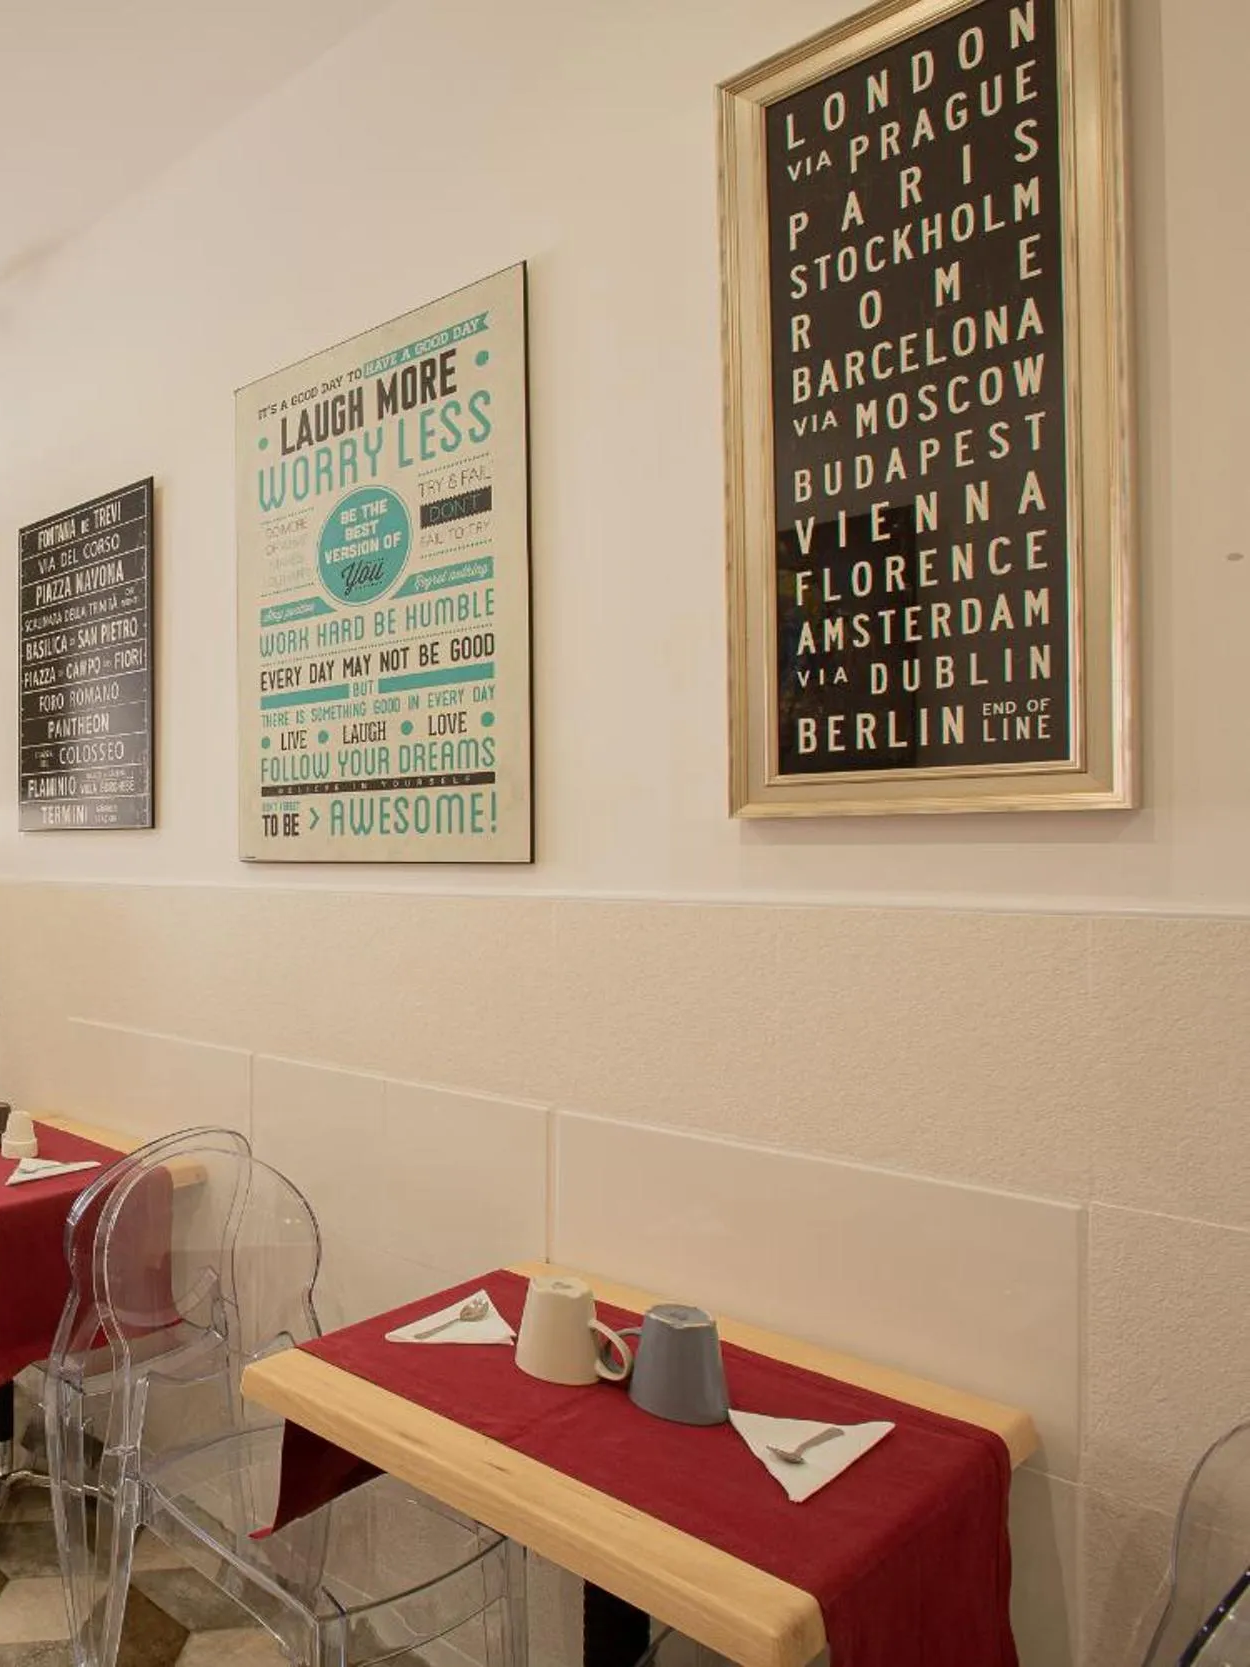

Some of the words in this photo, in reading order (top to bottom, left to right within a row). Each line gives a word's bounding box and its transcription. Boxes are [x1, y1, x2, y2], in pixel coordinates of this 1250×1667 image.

[786, 1, 1036, 151] LONDON
[787, 150, 832, 181] VIA
[851, 60, 1037, 173] PRAGUE
[790, 119, 1039, 251] PARIS
[790, 177, 1040, 299] STOCKHOLM
[791, 234, 1042, 352] ROME
[281, 399, 289, 410] A
[291, 386, 319, 404] GOOD
[321, 375, 343, 393] DAY
[347, 368, 362, 382] TO
[365, 352, 398, 373] HAVE
[401, 347, 412, 362] A
[414, 331, 449, 354] GOOD
[453, 318, 481, 340] DAY
[792, 298, 1044, 404] BARCELONA
[281, 386, 364, 455] LAUGH
[377, 349, 458, 420] MORE
[793, 410, 838, 437] VIA
[855, 354, 1044, 438] MOSCOW
[258, 426, 384, 512] WORRY
[398, 390, 492, 468] LESS
[794, 412, 1046, 502] BUDAPEST
[38, 519, 76, 550] FONTANA
[93, 501, 121, 529] TREVI
[340, 508, 357, 525] BE
[362, 499, 388, 518] THE
[345, 519, 379, 541] BEST
[795, 470, 1046, 554] VIENNA
[38, 555, 56, 575] VIA
[61, 548, 78, 567] DEL
[83, 533, 121, 559] CORSO
[324, 536, 380, 564] VERSION
[383, 531, 402, 549] OF
[796, 530, 1047, 606] FLORENCE
[36, 576, 72, 606] PIAZZA
[76, 560, 124, 594] NAVONA
[26, 634, 68, 660] BASILICA
[78, 625, 98, 649] SAN
[101, 616, 138, 644] PIETRO
[259, 626, 310, 658] WORK
[317, 615, 364, 647] HARD
[374, 608, 396, 638] BE
[405, 588, 495, 631] HUMBLE
[797, 588, 1049, 655] AMSTERDAM
[24, 666, 56, 688] PIAZZA
[66, 656, 101, 679] CAMPO
[114, 647, 143, 670] FIORI
[261, 667, 302, 692] EVERY
[310, 661, 334, 684] DAY
[342, 653, 371, 679] MAY
[380, 647, 410, 673] NOT
[419, 642, 440, 667] BE
[451, 633, 495, 662] GOOD
[798, 667, 848, 687] VIA
[871, 645, 1050, 695] DUBLIN
[39, 692, 65, 713] FORO
[70, 680, 120, 708] ROMANO
[262, 711, 289, 728] THERE
[296, 709, 305, 724] IS
[311, 700, 366, 723] SOMETHING
[373, 697, 401, 716] GOOD
[408, 693, 419, 710] IN
[428, 688, 465, 709] EVERY
[473, 684, 496, 703] DAY
[353, 680, 375, 697] BUT
[982, 701, 1016, 716] END
[1026, 699, 1050, 713] OF
[48, 712, 110, 739] PANTHEON
[280, 730, 308, 751] LIVE
[343, 721, 386, 745] LAUGH
[428, 712, 467, 737] LOVE
[798, 705, 964, 754] BERLIN
[982, 715, 1050, 742] LINE
[59, 741, 125, 765] COLOSSEO
[261, 751, 330, 783] FOLLOW
[338, 746, 390, 777] YOUR
[399, 737, 496, 774] DREAMS
[28, 776, 76, 799] FLAMINIO
[352, 782, 367, 790] IN
[380, 776, 471, 789] YOURSELF
[41, 804, 88, 825] TERMINI
[262, 814, 278, 837] TO
[283, 813, 300, 837] BE
[330, 791, 497, 837] AWESOME!
